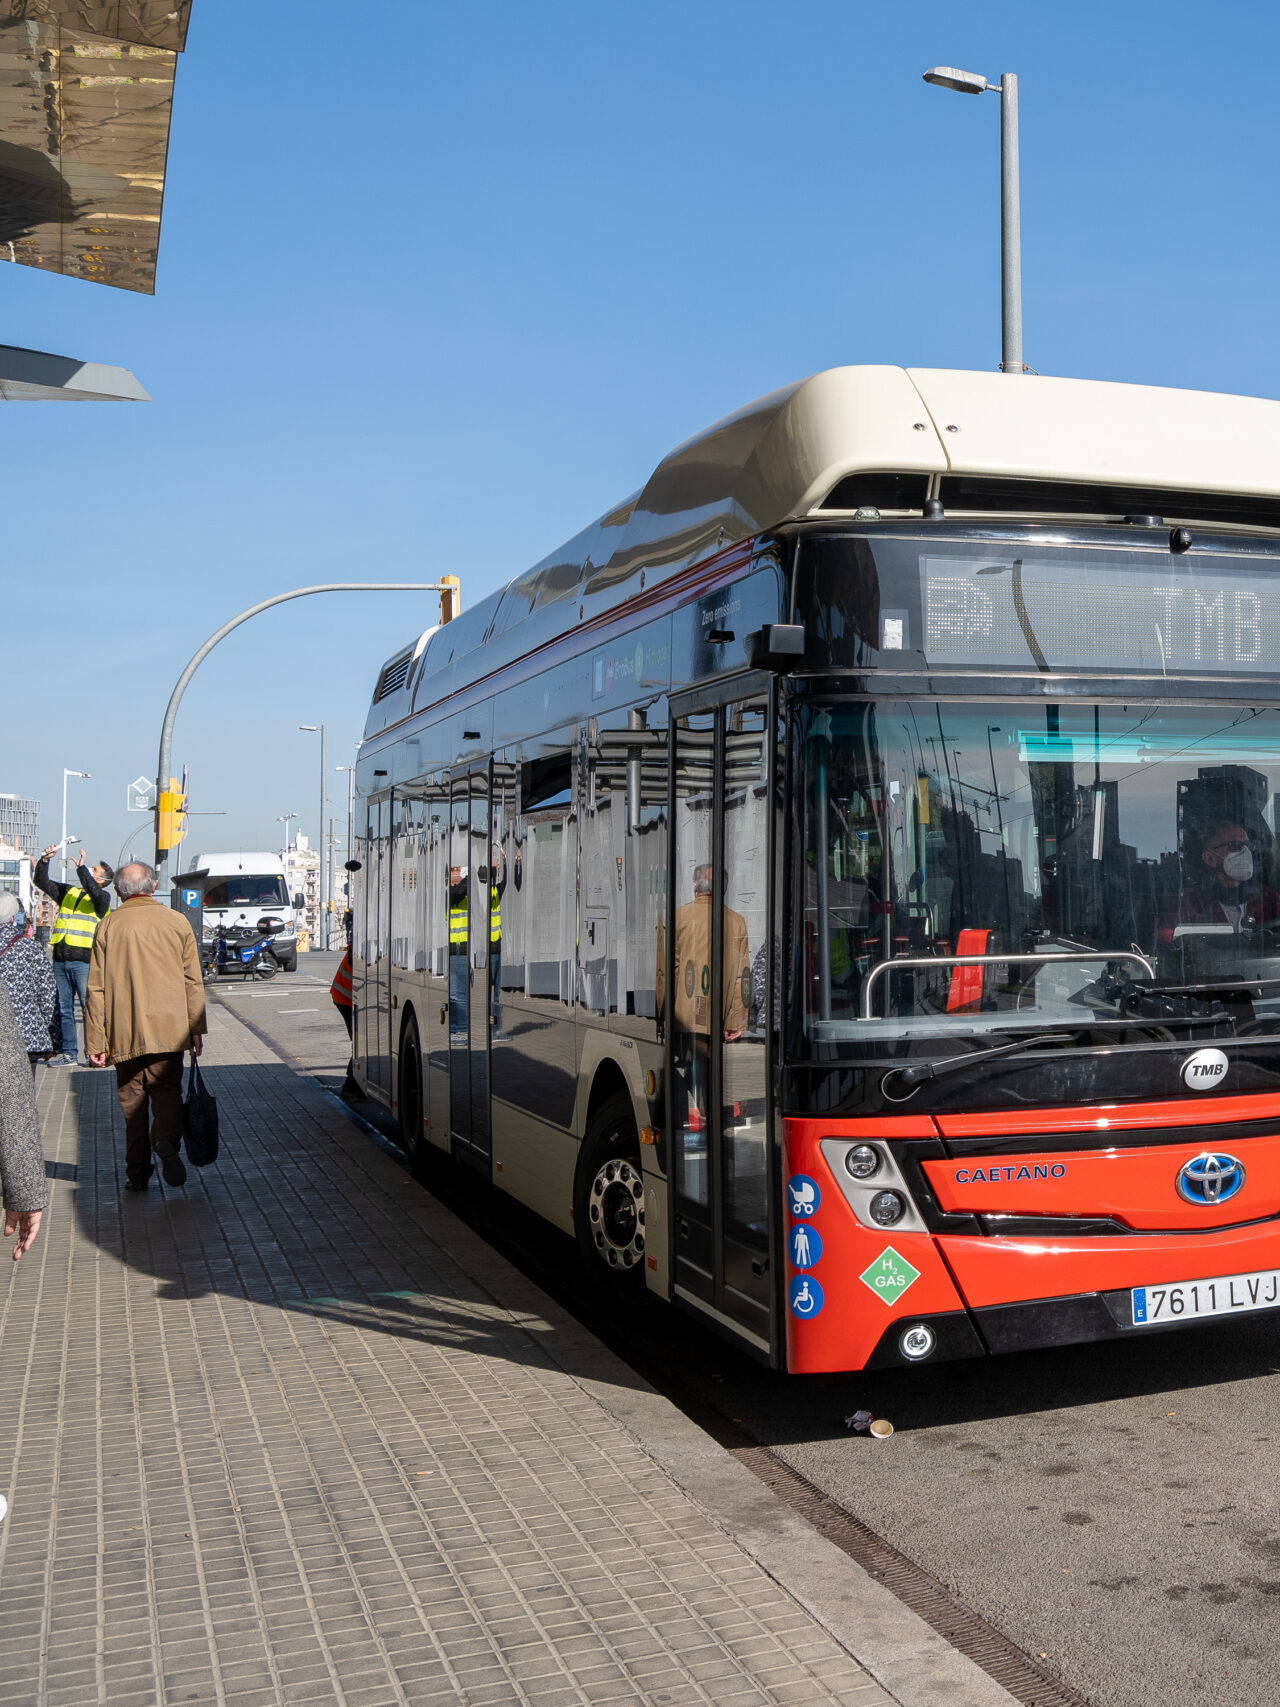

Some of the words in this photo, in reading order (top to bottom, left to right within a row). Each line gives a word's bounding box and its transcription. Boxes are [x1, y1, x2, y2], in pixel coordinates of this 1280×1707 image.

[702, 610, 714, 626] Zero
[715, 599, 741, 621] emissions
[1153, 588, 1261, 661] TMB
[186, 891, 198, 905] P
[1192, 1063, 1224, 1077] TMB
[955, 1163, 1066, 1184] CAETANO
[875, 1275, 906, 1287] GAS
[1137, 1309, 1144, 1318] E
[1151, 1283, 1217, 1318] 7611
[1229, 1276, 1278, 1308] LVJ
